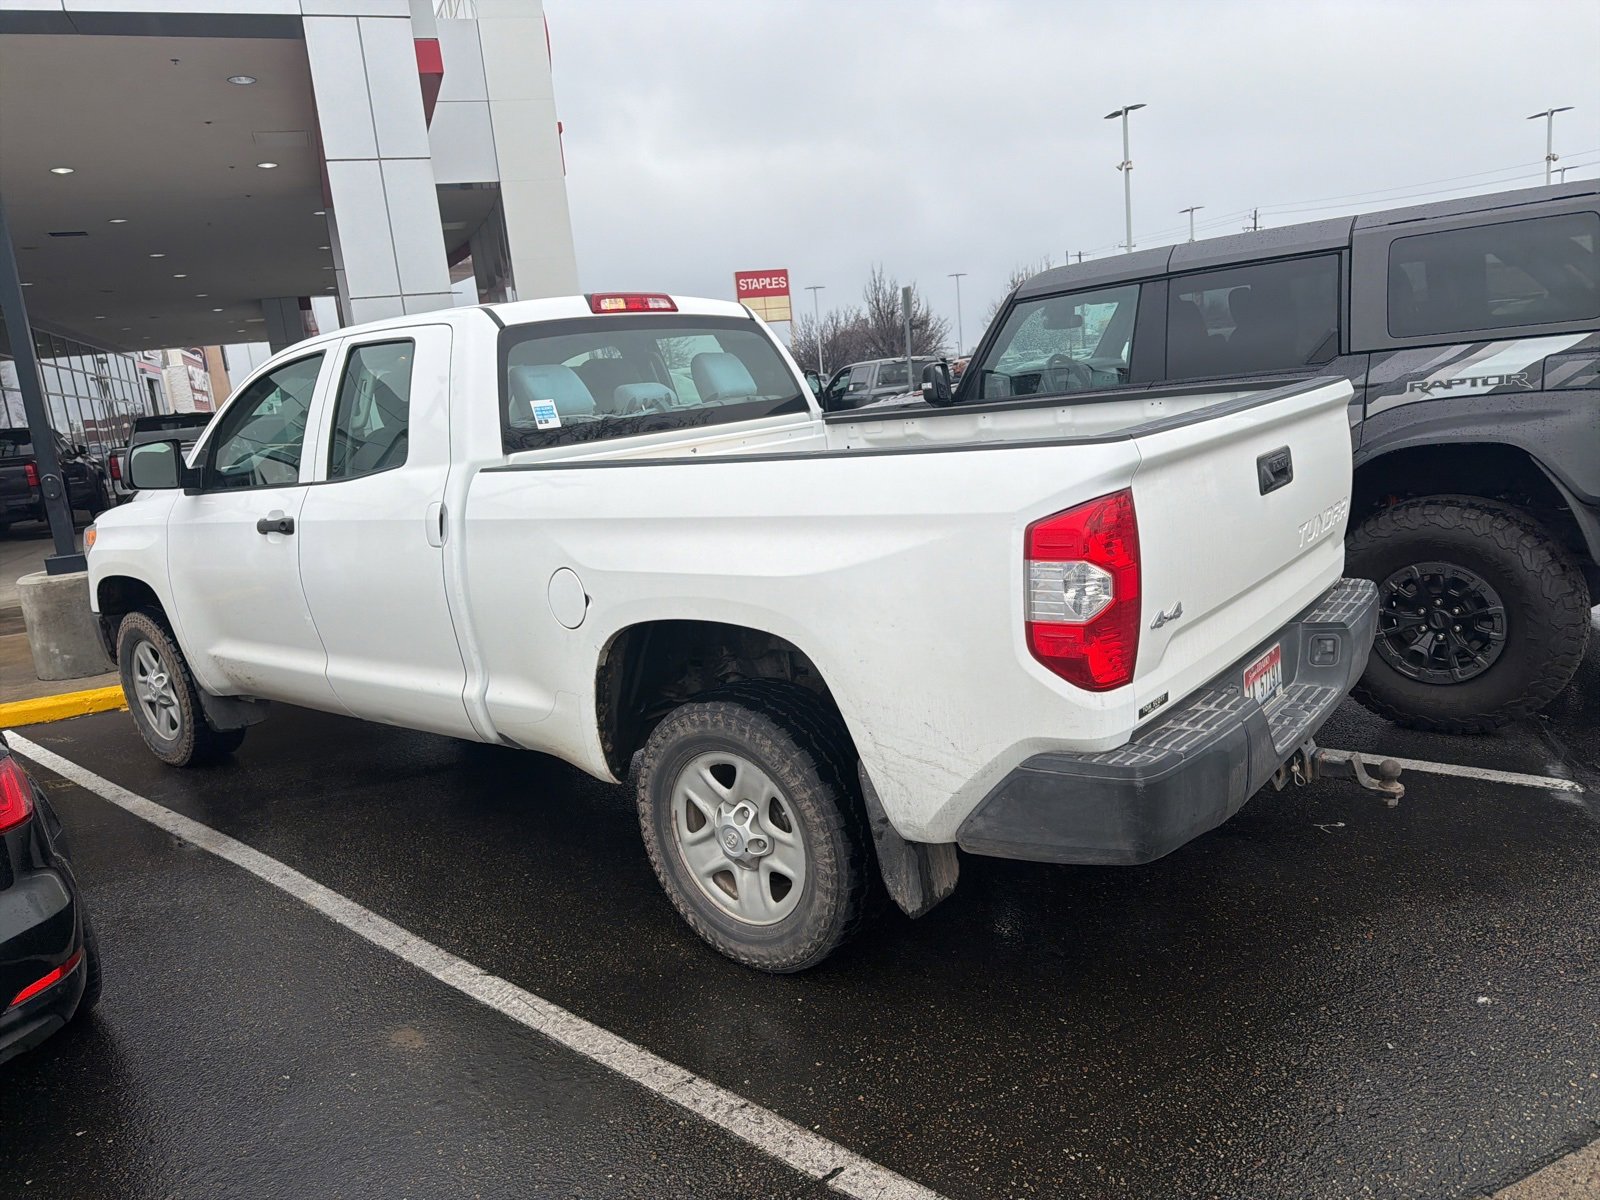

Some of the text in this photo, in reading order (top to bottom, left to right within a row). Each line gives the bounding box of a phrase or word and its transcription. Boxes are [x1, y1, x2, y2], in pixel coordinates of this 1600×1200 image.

[738, 276, 787, 291] STAPLES
[1406, 372, 1533, 396] RAPTOR
[1298, 496, 1348, 548] TUNDRA
